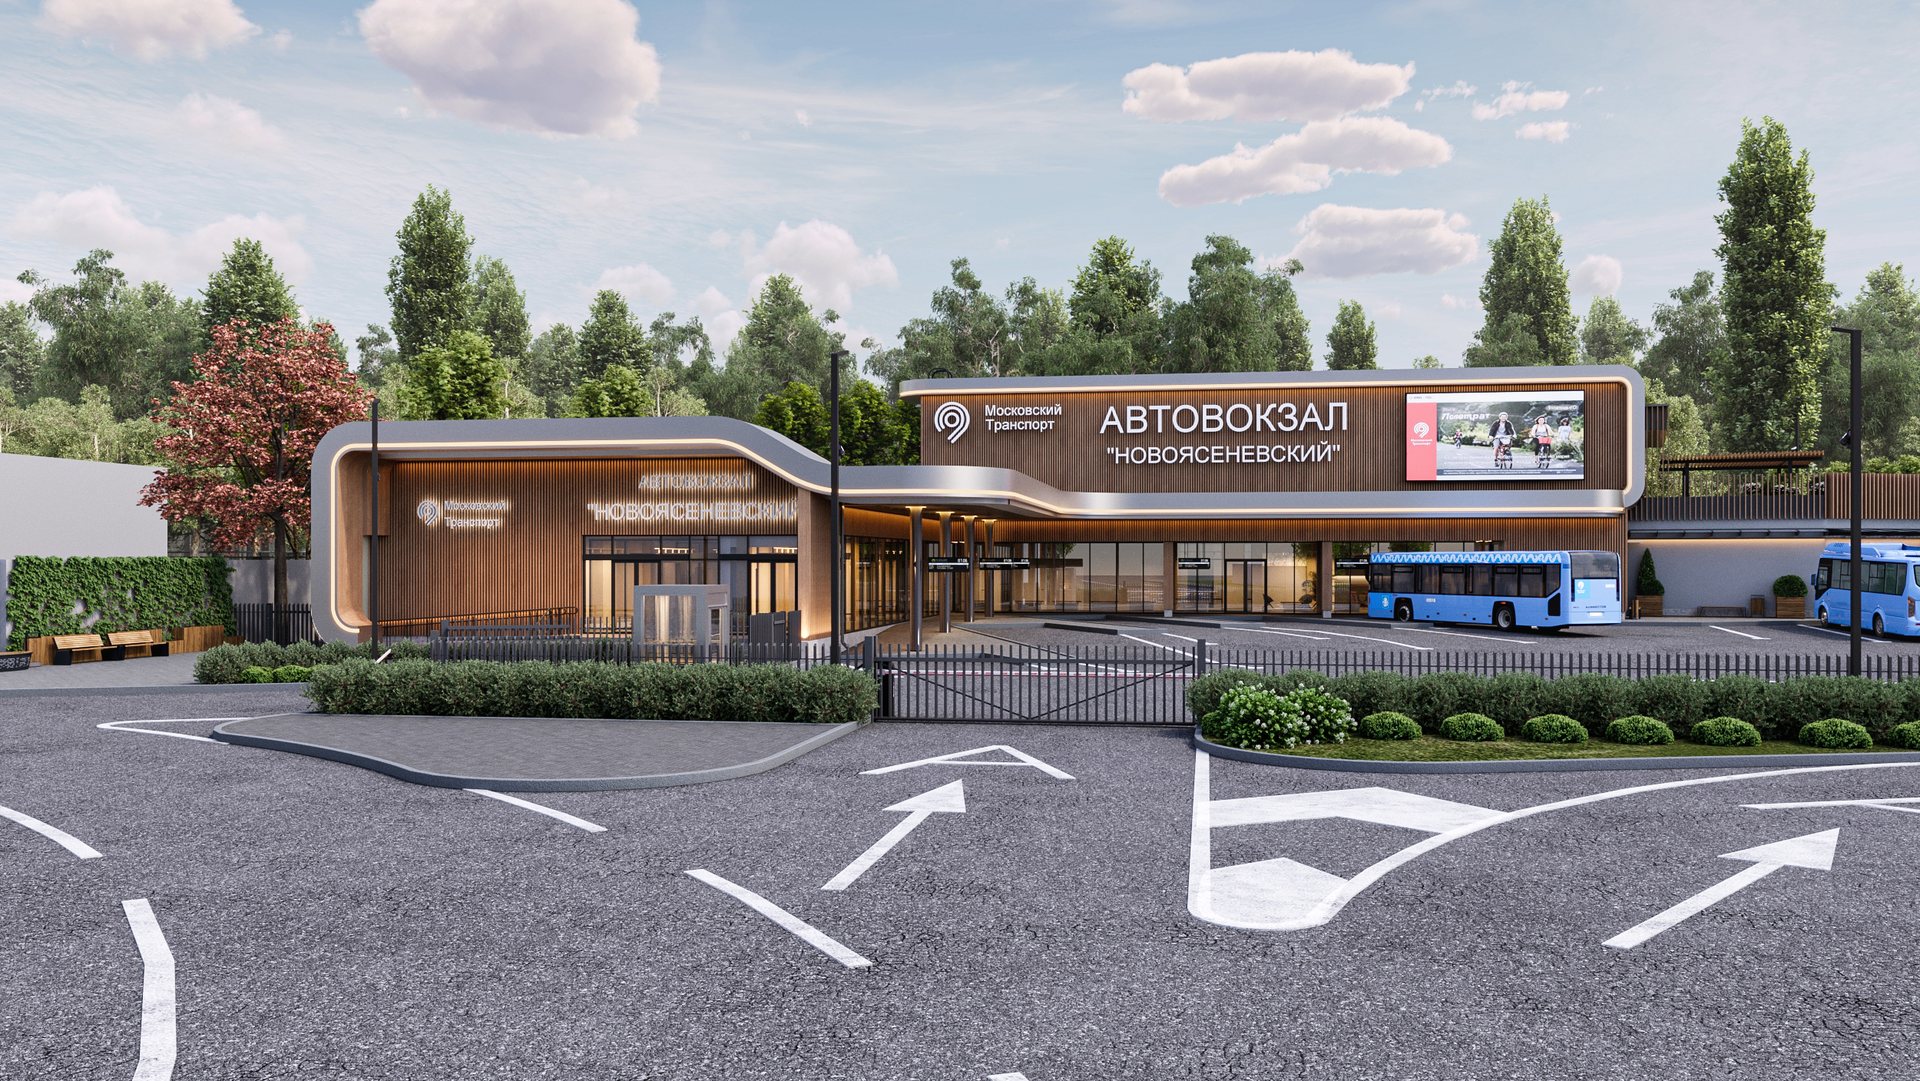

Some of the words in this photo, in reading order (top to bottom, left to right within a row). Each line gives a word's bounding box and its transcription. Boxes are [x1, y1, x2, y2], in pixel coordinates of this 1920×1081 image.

[985, 404, 1062, 416] Московский
[985, 418, 1055, 432] Транспорт
[1100, 402, 1348, 434] АВТОВОКЗАЛ
[1107, 441, 1341, 464] "НОВОЯСЕНЕВСКИЙ"
[638, 473, 752, 490] АВТОВОКЗАЛ
[444, 499, 507, 511] Московский
[444, 516, 500, 529] Транспорт
